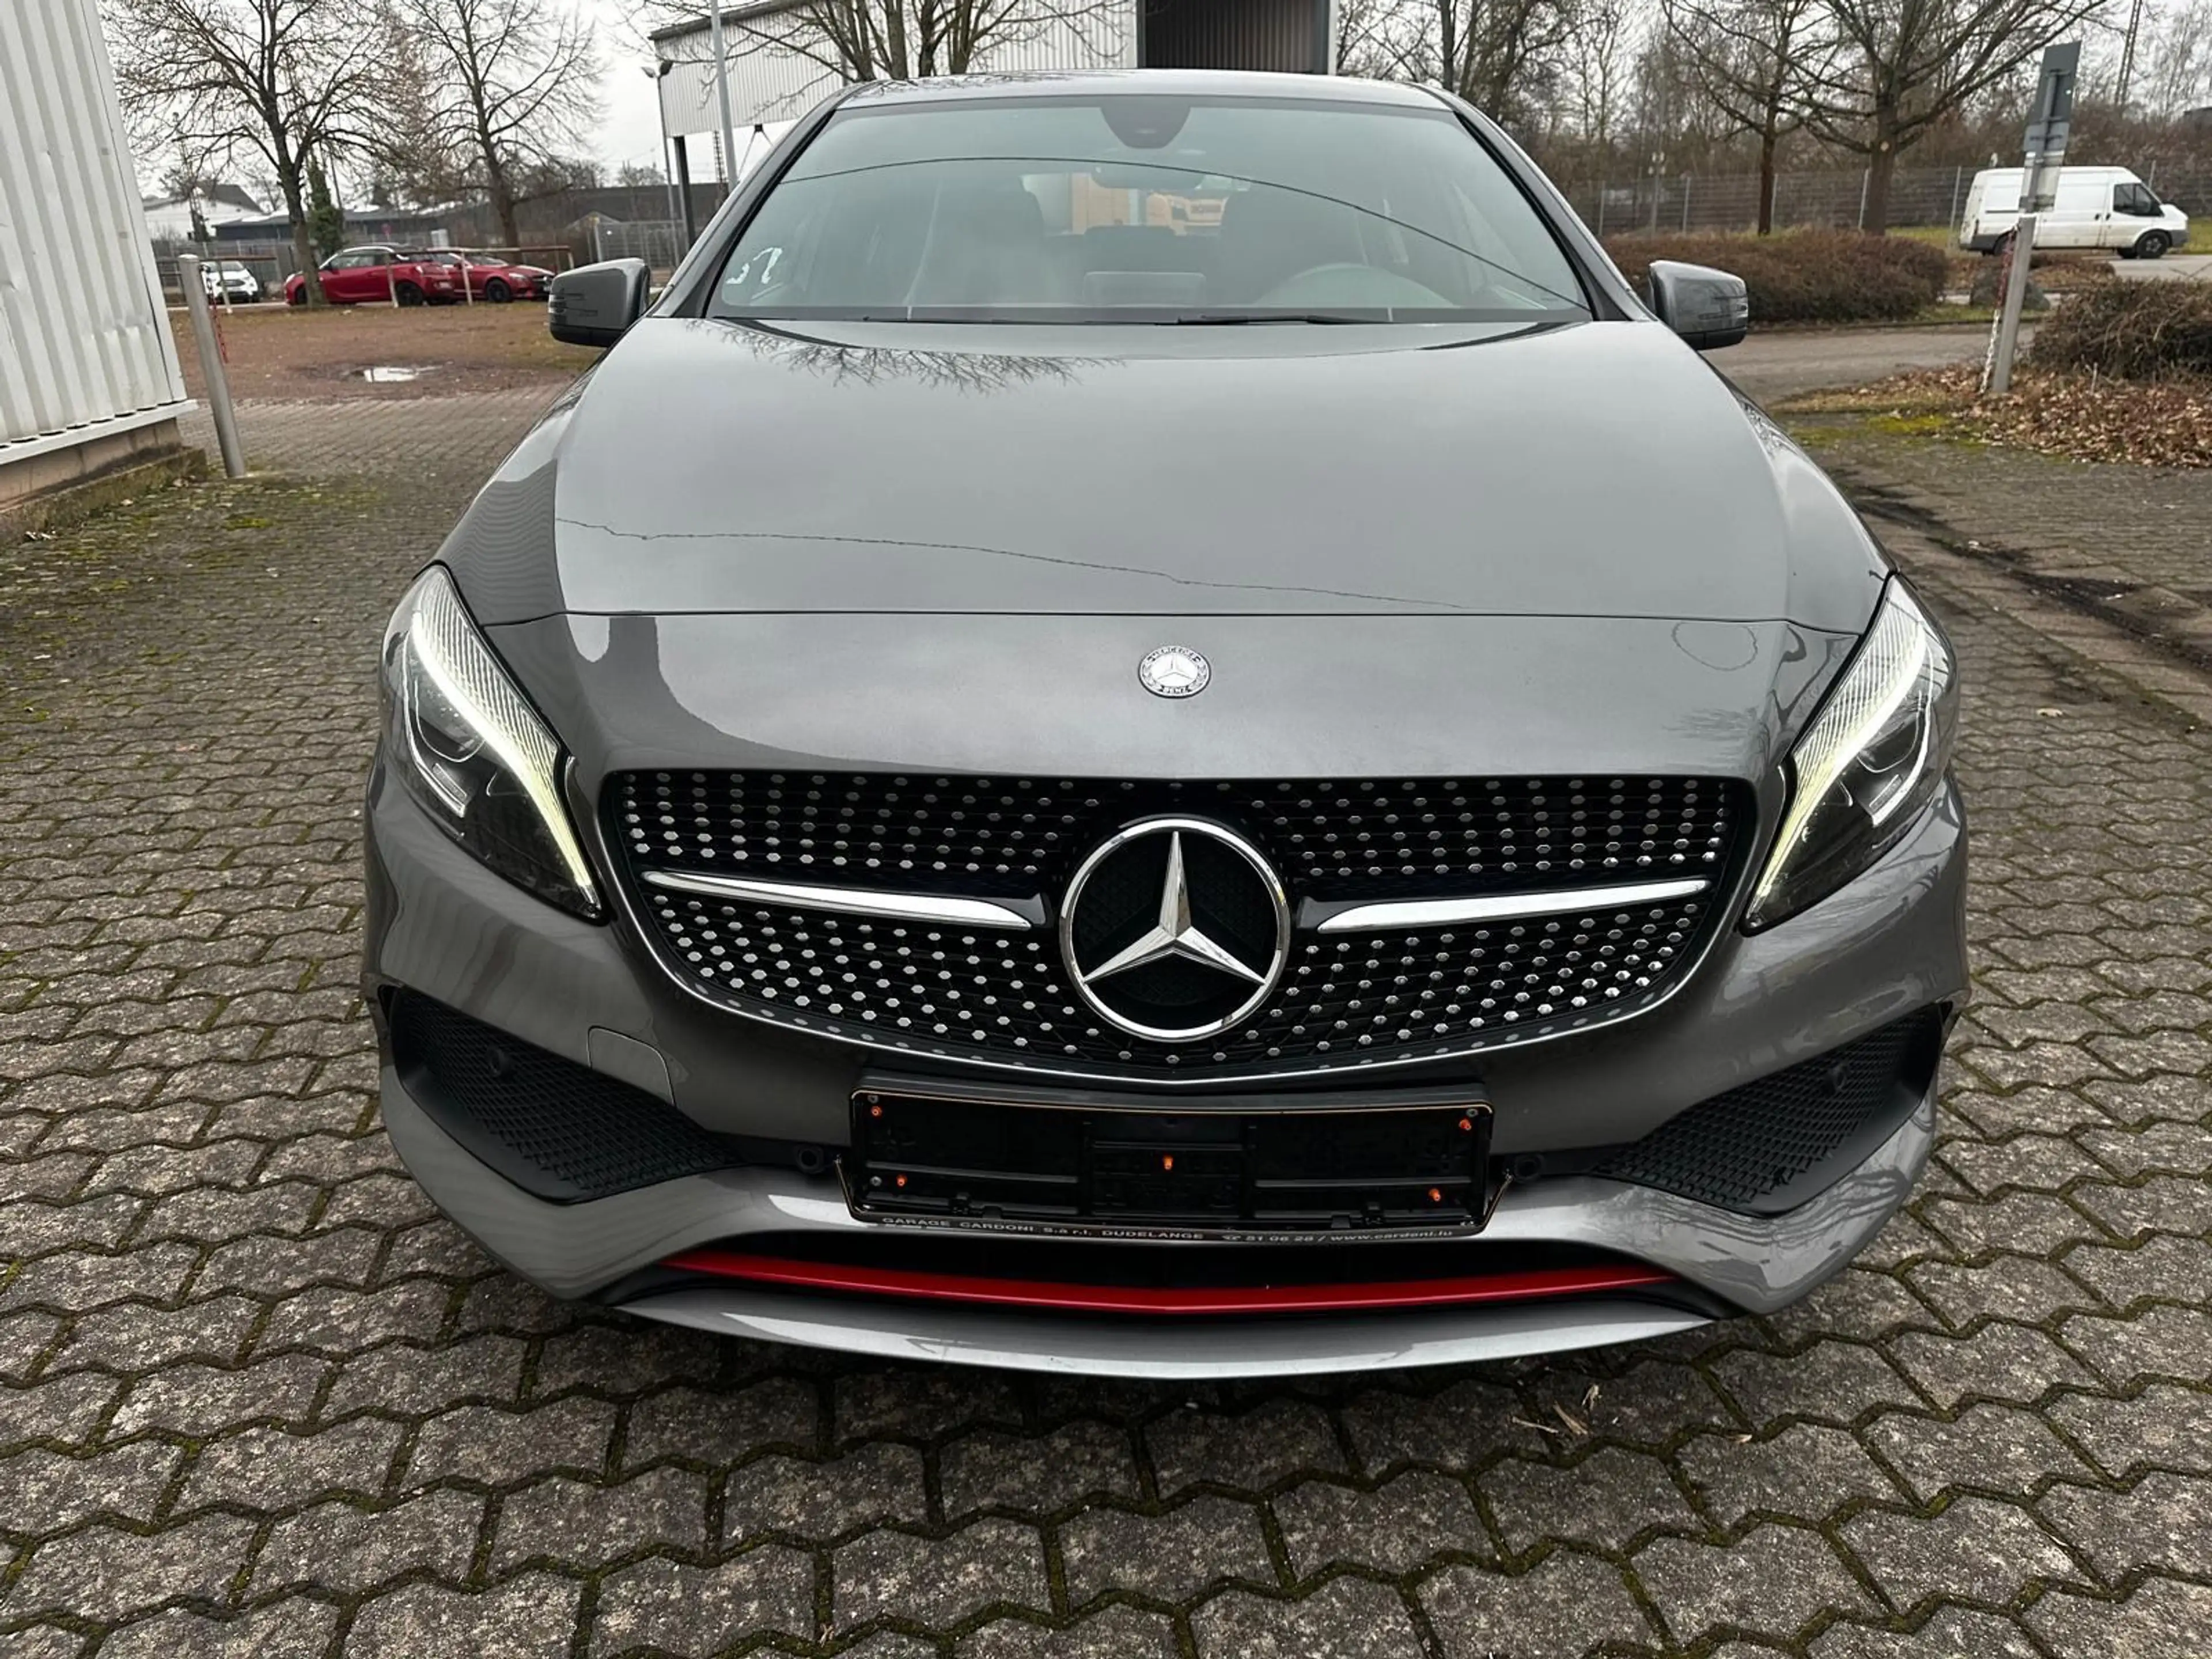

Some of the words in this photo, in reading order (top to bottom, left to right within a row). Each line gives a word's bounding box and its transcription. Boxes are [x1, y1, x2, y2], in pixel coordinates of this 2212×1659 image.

[882, 1217, 950, 1227] GARAGE
[959, 1222, 1033, 1232] CARDONI
[1101, 1230, 1203, 1240] DUDELANGE
